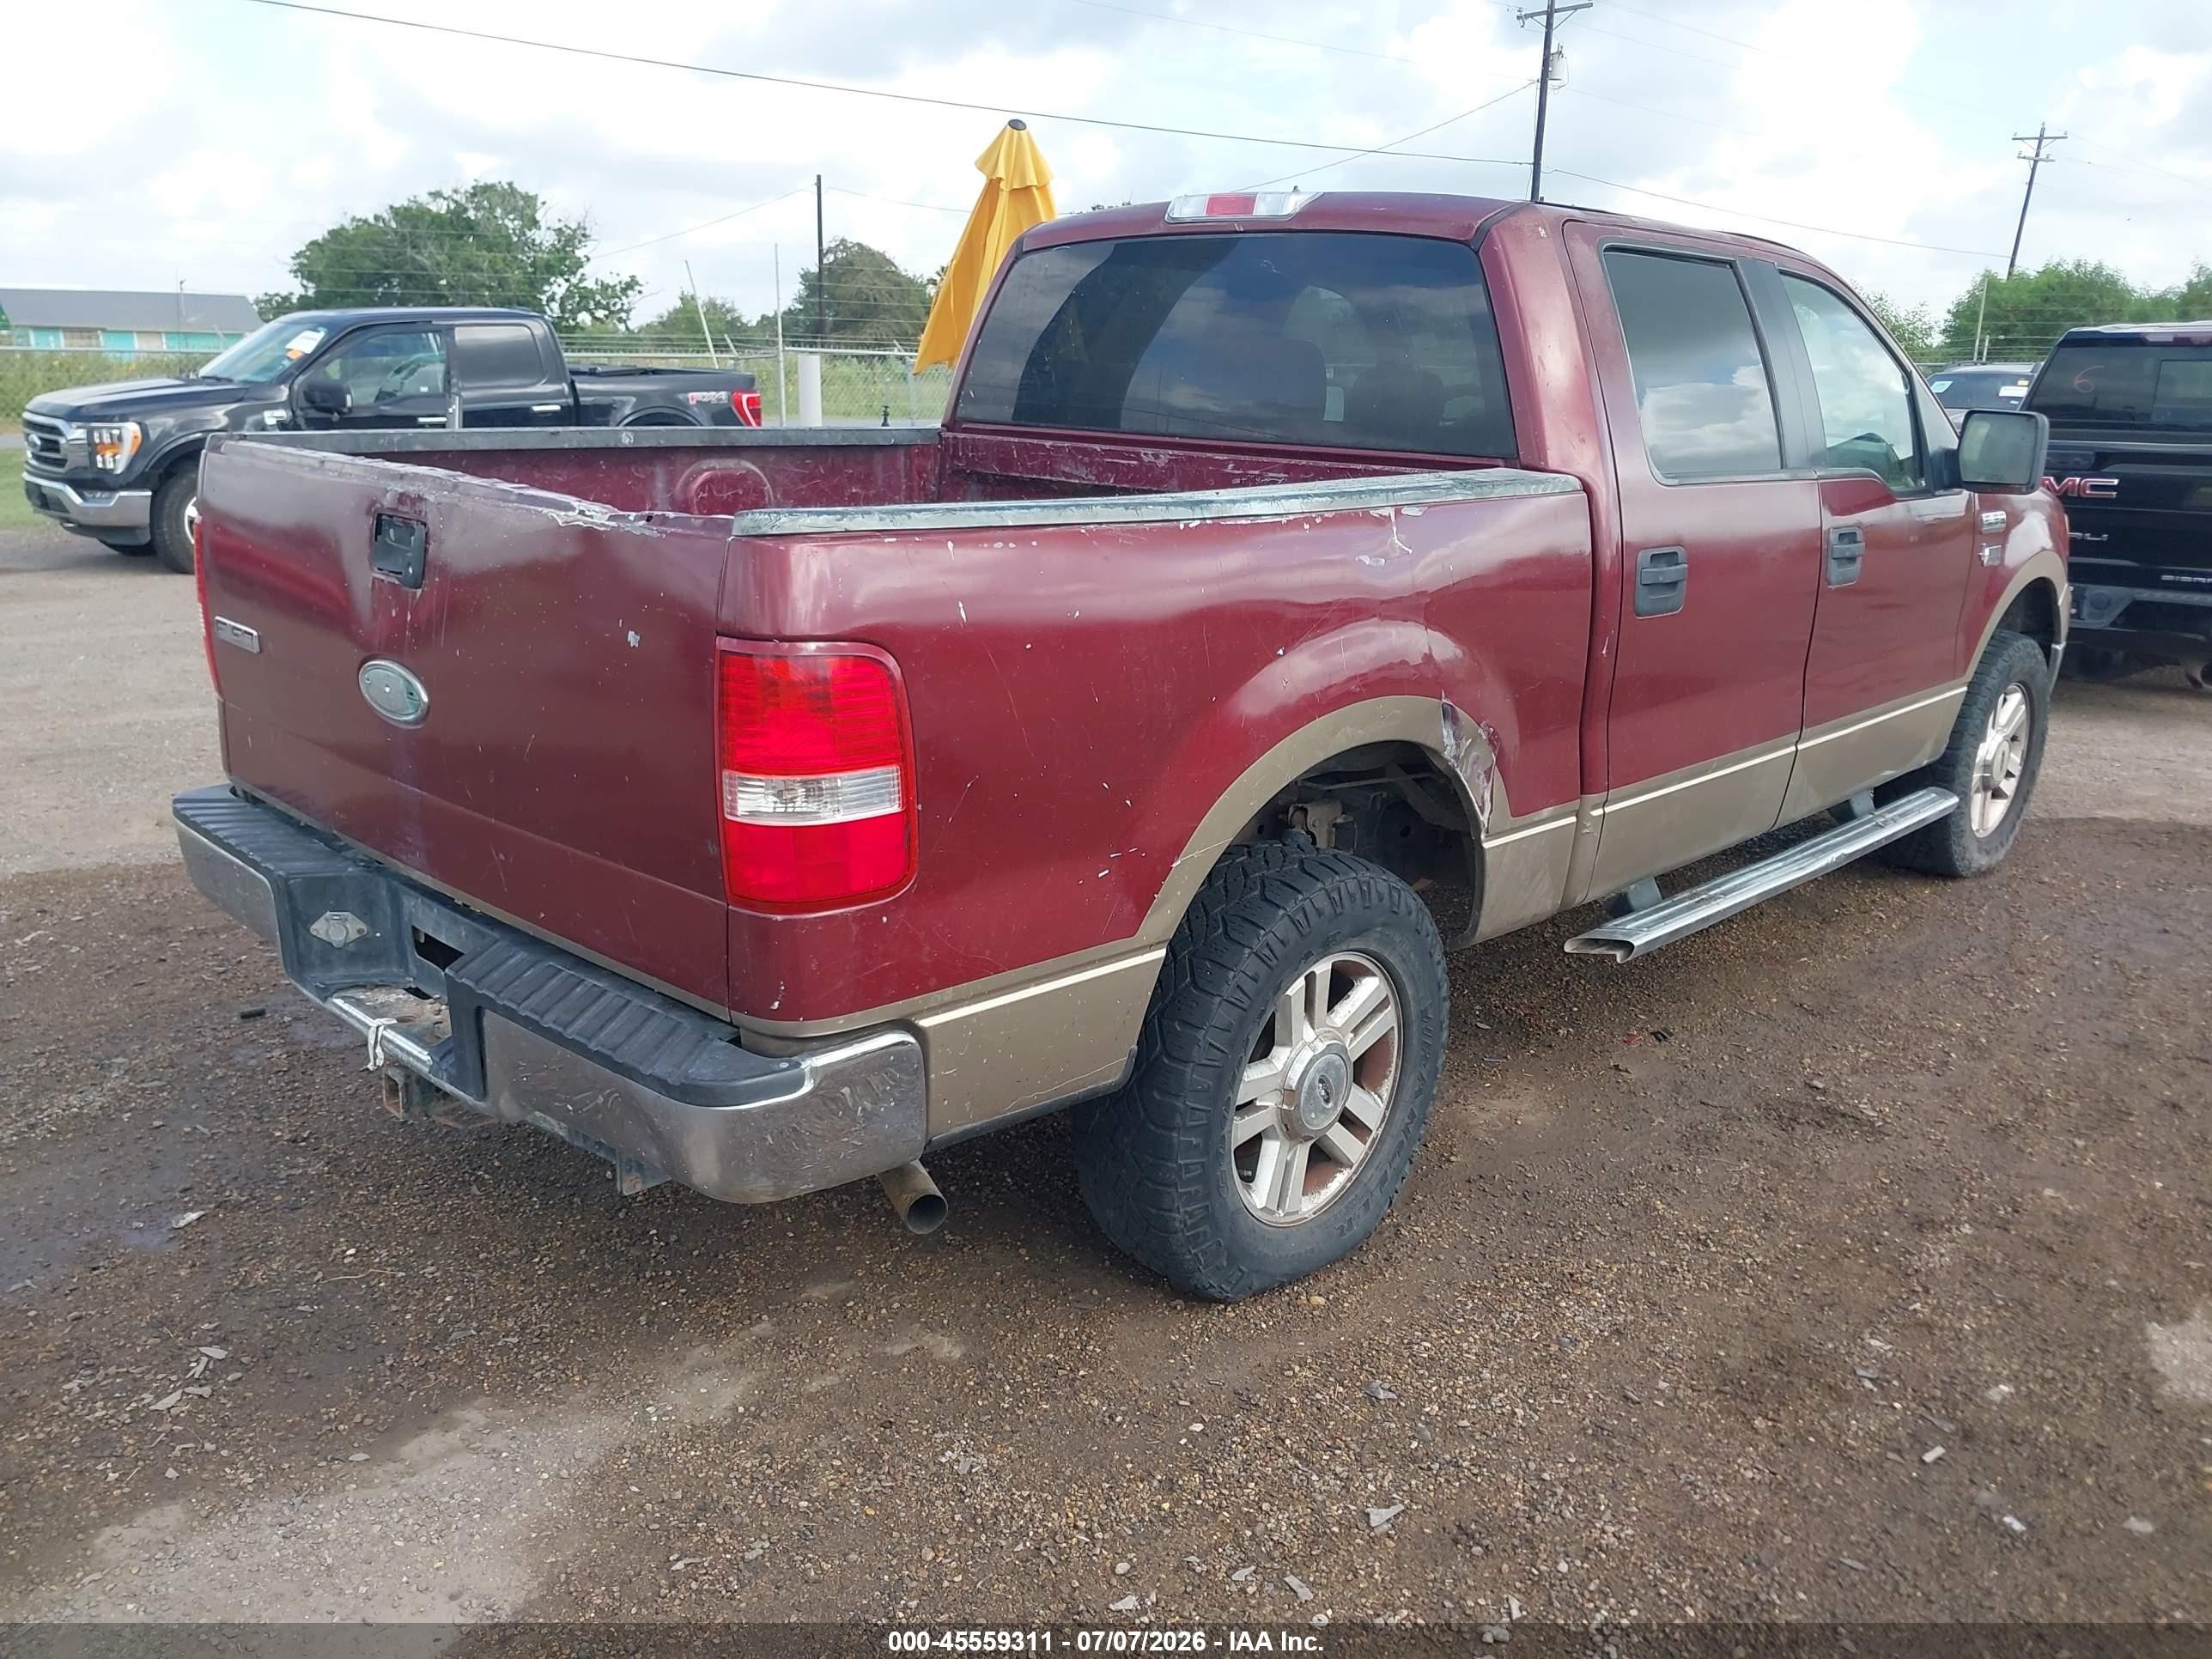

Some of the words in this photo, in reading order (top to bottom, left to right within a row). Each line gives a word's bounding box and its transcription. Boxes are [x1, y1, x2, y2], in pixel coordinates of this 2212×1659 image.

[2074, 365, 2106, 393] 6
[688, 391, 728, 405] FX4
[2040, 476, 2119, 499] MC
